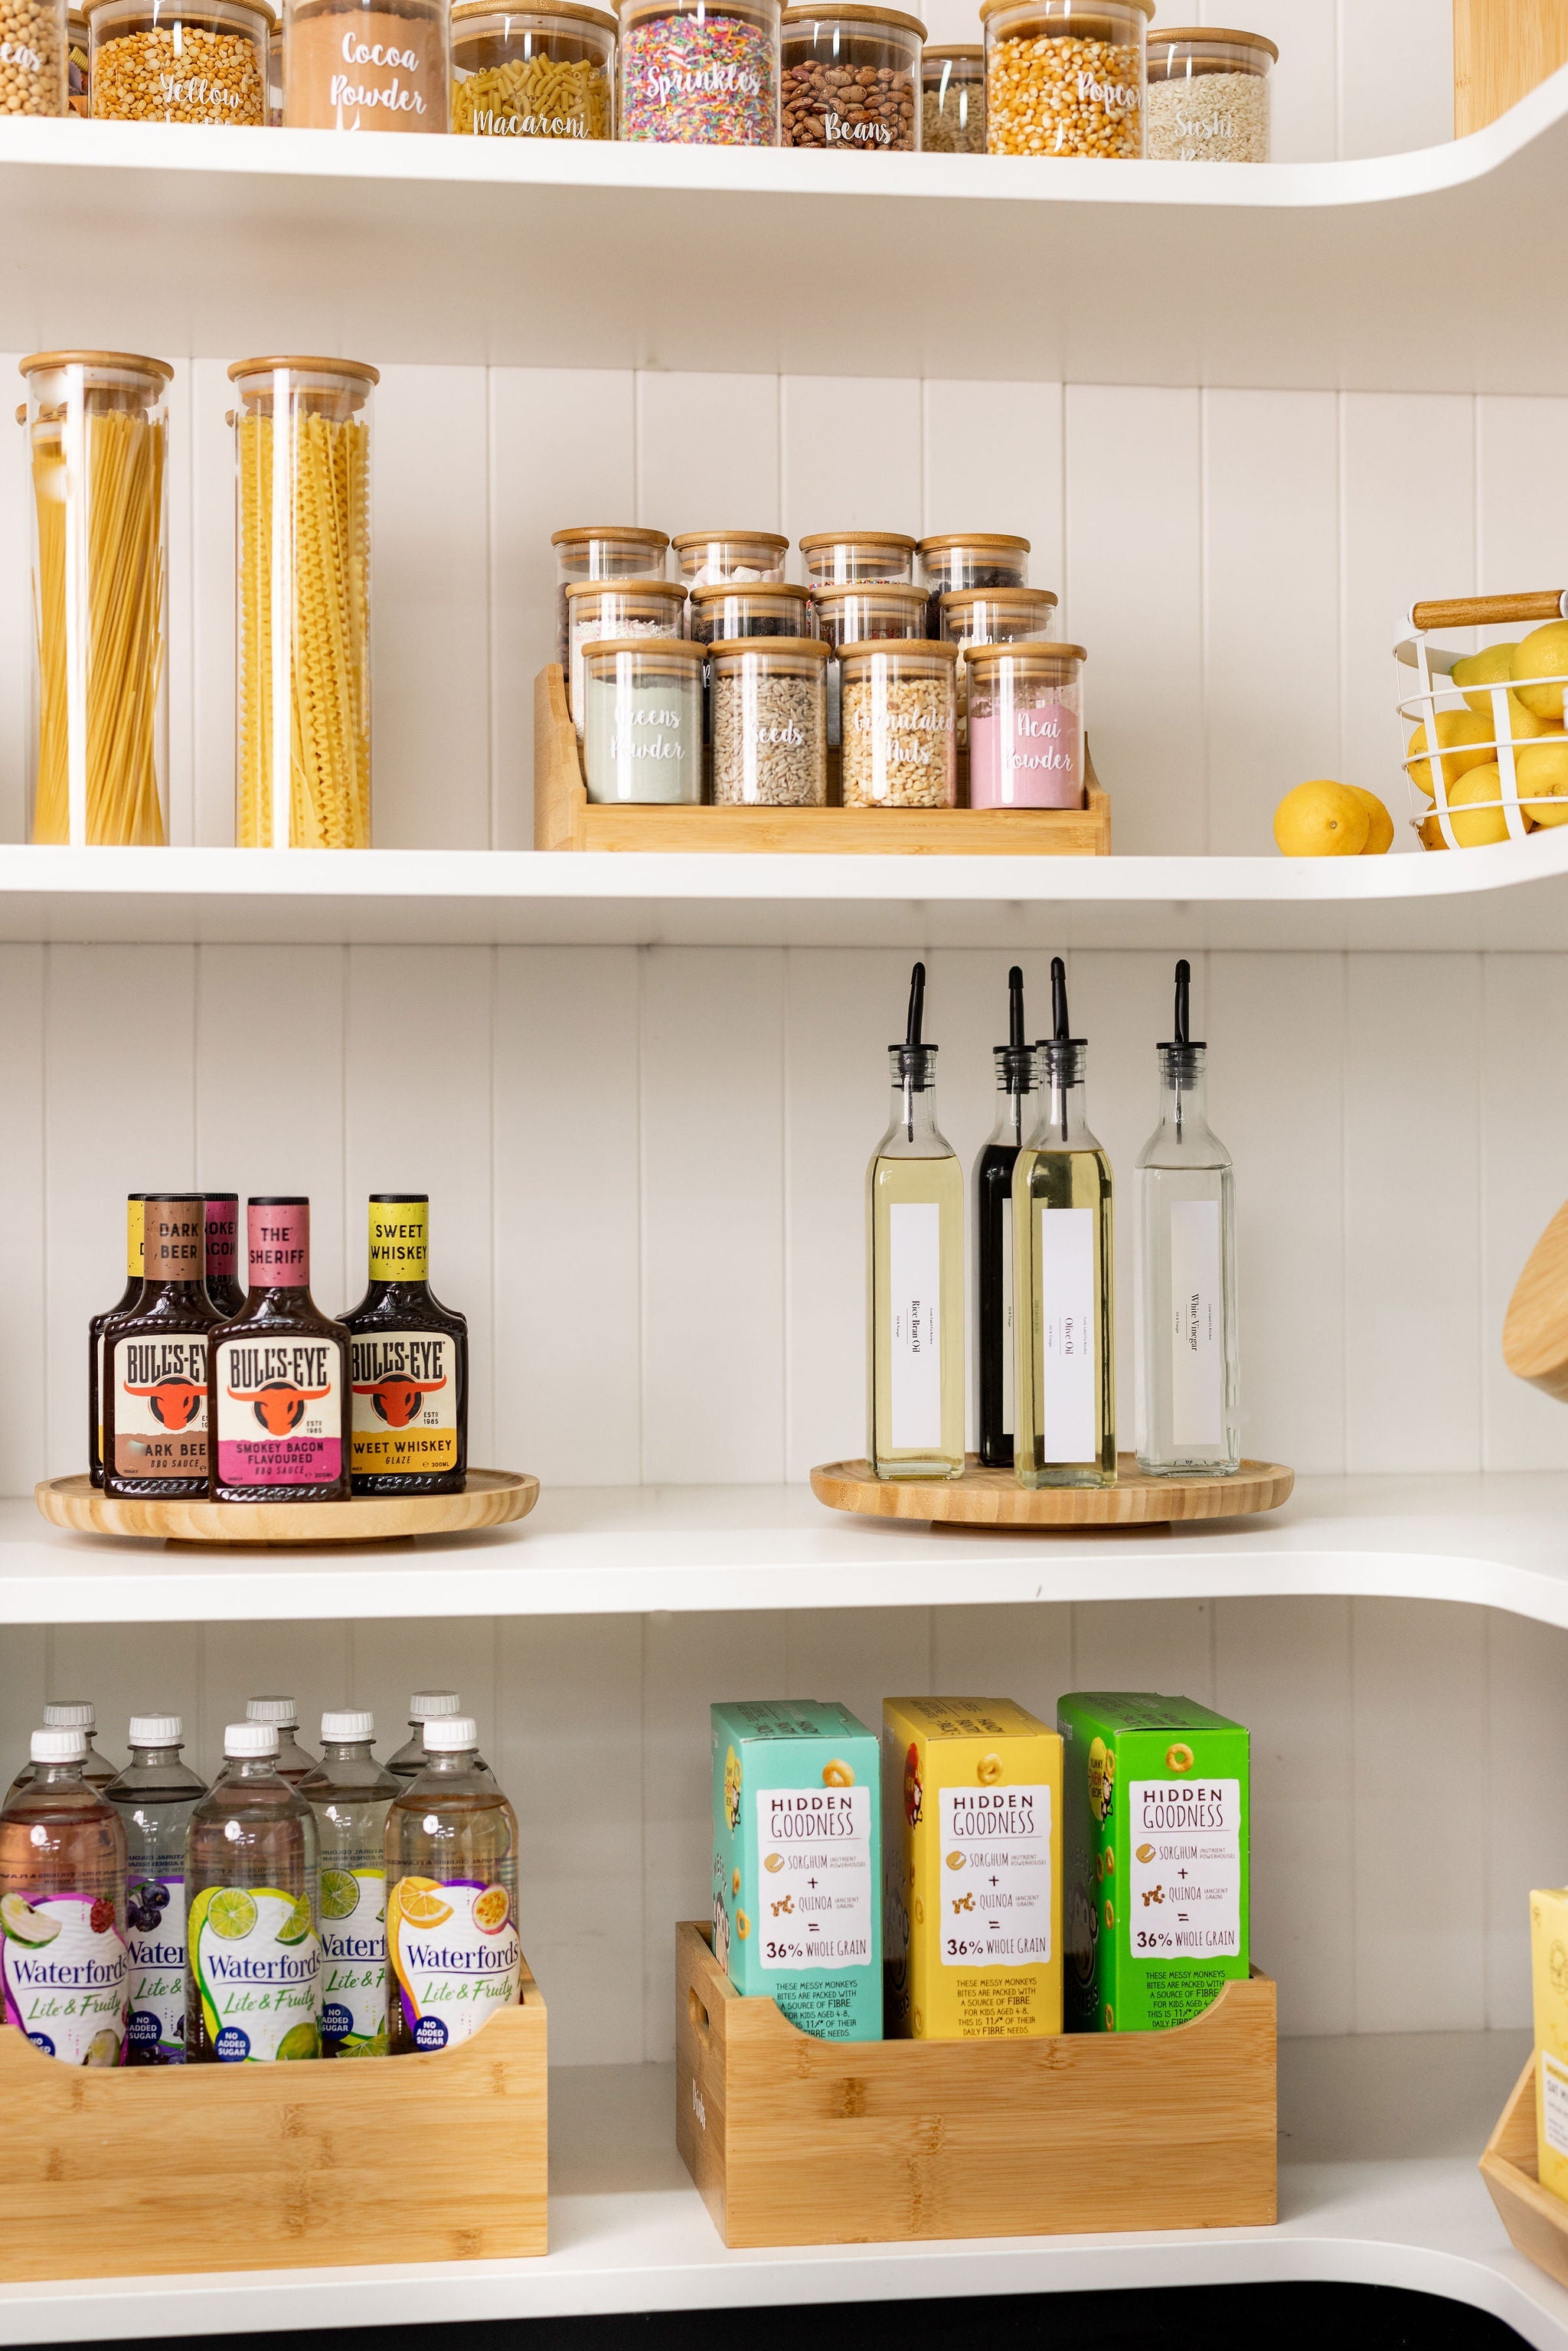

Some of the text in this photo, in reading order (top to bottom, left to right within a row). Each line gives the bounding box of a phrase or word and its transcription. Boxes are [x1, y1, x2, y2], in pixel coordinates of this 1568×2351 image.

[342, 31, 419, 72] Cocoa
[160, 73, 243, 109] Yellow
[647, 61, 761, 106] Sprinkles
[331, 75, 426, 114] Powder
[472, 109, 589, 139] Macaroni
[825, 113, 893, 144] Beans
[1174, 109, 1237, 139] Sushi
[1018, 712, 1061, 739] Acai
[887, 739, 932, 766] Nuts
[159, 1223, 199, 1237] DARK
[261, 1228, 289, 1242] THE
[376, 1224, 423, 1238] SWEET
[160, 1245, 198, 1259] BEER
[250, 1249, 305, 1264] SHERIFF
[371, 1246, 427, 1260] WHISKEY
[912, 1301, 920, 1353] Rice Bran Oil
[1065, 1318, 1073, 1354] Olive Oil
[1189, 1320, 1199, 1351] Vinegar
[145, 1443, 207, 1456] ARK BEE
[237, 1442, 324, 1453] SMOKEY BACON
[353, 1440, 452, 1454] WEET WHISKEY
[151, 1459, 199, 1468] BBQ SAUCE
[248, 1454, 312, 1464] FLAVOURED
[386, 1455, 411, 1464] GLAZE
[276, 1466, 305, 1474] SAUCE
[954, 1794, 1033, 1810] HIDDEN
[1144, 1788, 1222, 1803] HIDDEN
[772, 1797, 851, 1811] HIDDEN
[953, 1811, 1034, 1836] GOODNESS
[1143, 1804, 1223, 1828] GOODNESS
[771, 1812, 854, 1837] GOODNESS
[970, 1853, 1008, 1867] SORGHUM
[1159, 1846, 1197, 1860] SORGHUM
[789, 1854, 828, 1871] SORGHUM
[979, 1893, 1013, 1910] QUINOA
[1168, 1886, 1201, 1902] QUINOA
[799, 1895, 832, 1912] QUINOA
[947, 1937, 1046, 1955] 36% WHOLE GRAIN
[1137, 1930, 1234, 1948] 36% WHOLE GRAIN
[407, 1941, 518, 1969] Waterfords
[766, 1939, 866, 1958] 36% WHOLE GRAIN
[207, 1951, 321, 1979] Waterfords
[170, 1978, 181, 1994] &
[361, 1971, 373, 1987] &
[825, 1980, 858, 1989] MONKEYS
[1004, 1977, 1037, 1986] MONKEYS
[456, 1984, 469, 1999] &
[472, 1975, 512, 2002] Fruity
[838, 1990, 857, 1998] WITH
[64, 1999, 76, 2015] &
[80, 1990, 121, 2016] Fruity
[259, 1994, 271, 2010] &
[275, 1984, 315, 2011] Fruity
[828, 1999, 851, 2008] FIBRE
[1008, 1996, 1030, 2005] FIBRE
[416, 2029, 444, 2037] ADDED
[982, 2026, 1004, 2035] FIBRE
[416, 2037, 444, 2046] SUGAR
[218, 2048, 246, 2056] SUGAR
